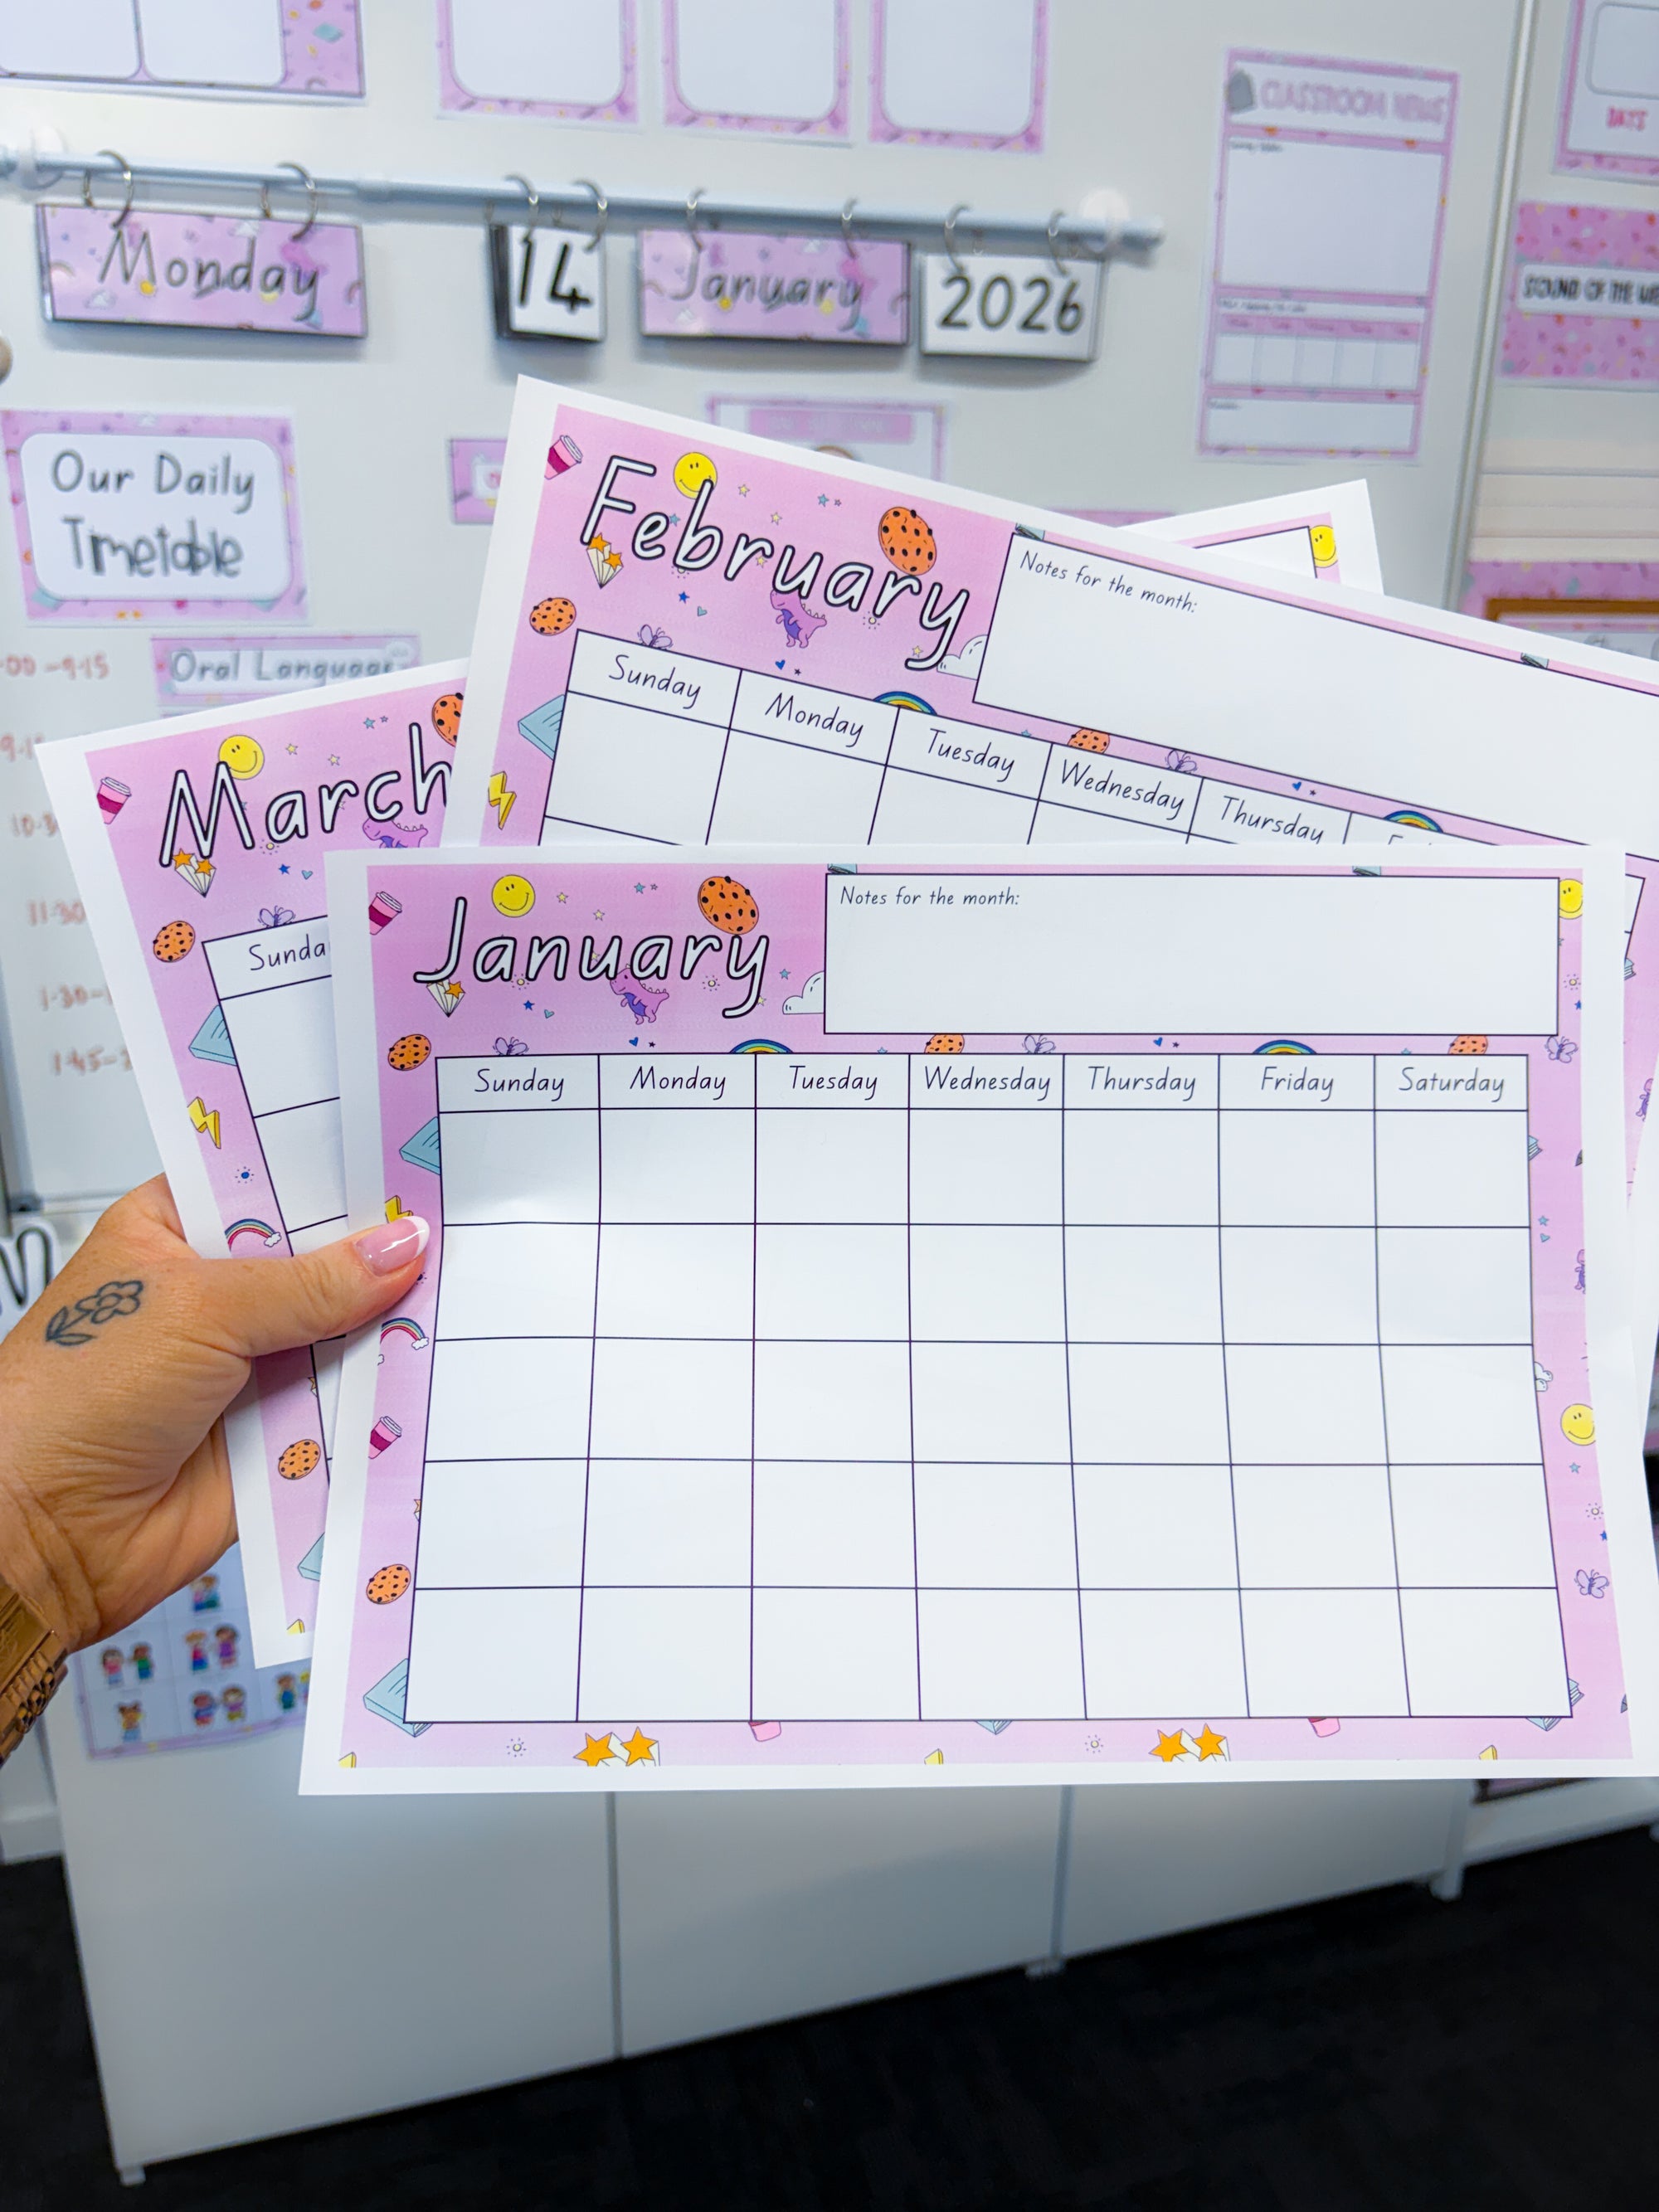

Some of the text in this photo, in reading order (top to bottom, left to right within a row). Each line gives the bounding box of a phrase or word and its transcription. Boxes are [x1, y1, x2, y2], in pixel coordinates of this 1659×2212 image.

[99, 230, 320, 322] Monday
[518, 237, 593, 313] 14
[671, 247, 865, 332] January
[938, 275, 1085, 333] 2026
[1524, 274, 1580, 300] SOUND
[1584, 277, 1607, 302] OF
[1608, 280, 1633, 305] THE
[51, 449, 255, 515] Our Daily
[580, 455, 970, 672] February
[1019, 550, 1198, 614] Notes for the month:
[172, 648, 241, 683] Oral
[608, 654, 703, 709] Sunday
[765, 692, 864, 748] Monday
[927, 727, 1016, 782] Tuesday
[1060, 758, 1185, 821] Wednesday
[158, 722, 452, 868] March
[840, 885, 1020, 906] Notes for the month:
[249, 933, 330, 971] Sunda
[414, 896, 770, 1019] January
[474, 1065, 1506, 1103] Sunday Monday Tuesday Wednesday Thursday Friday Saturday
